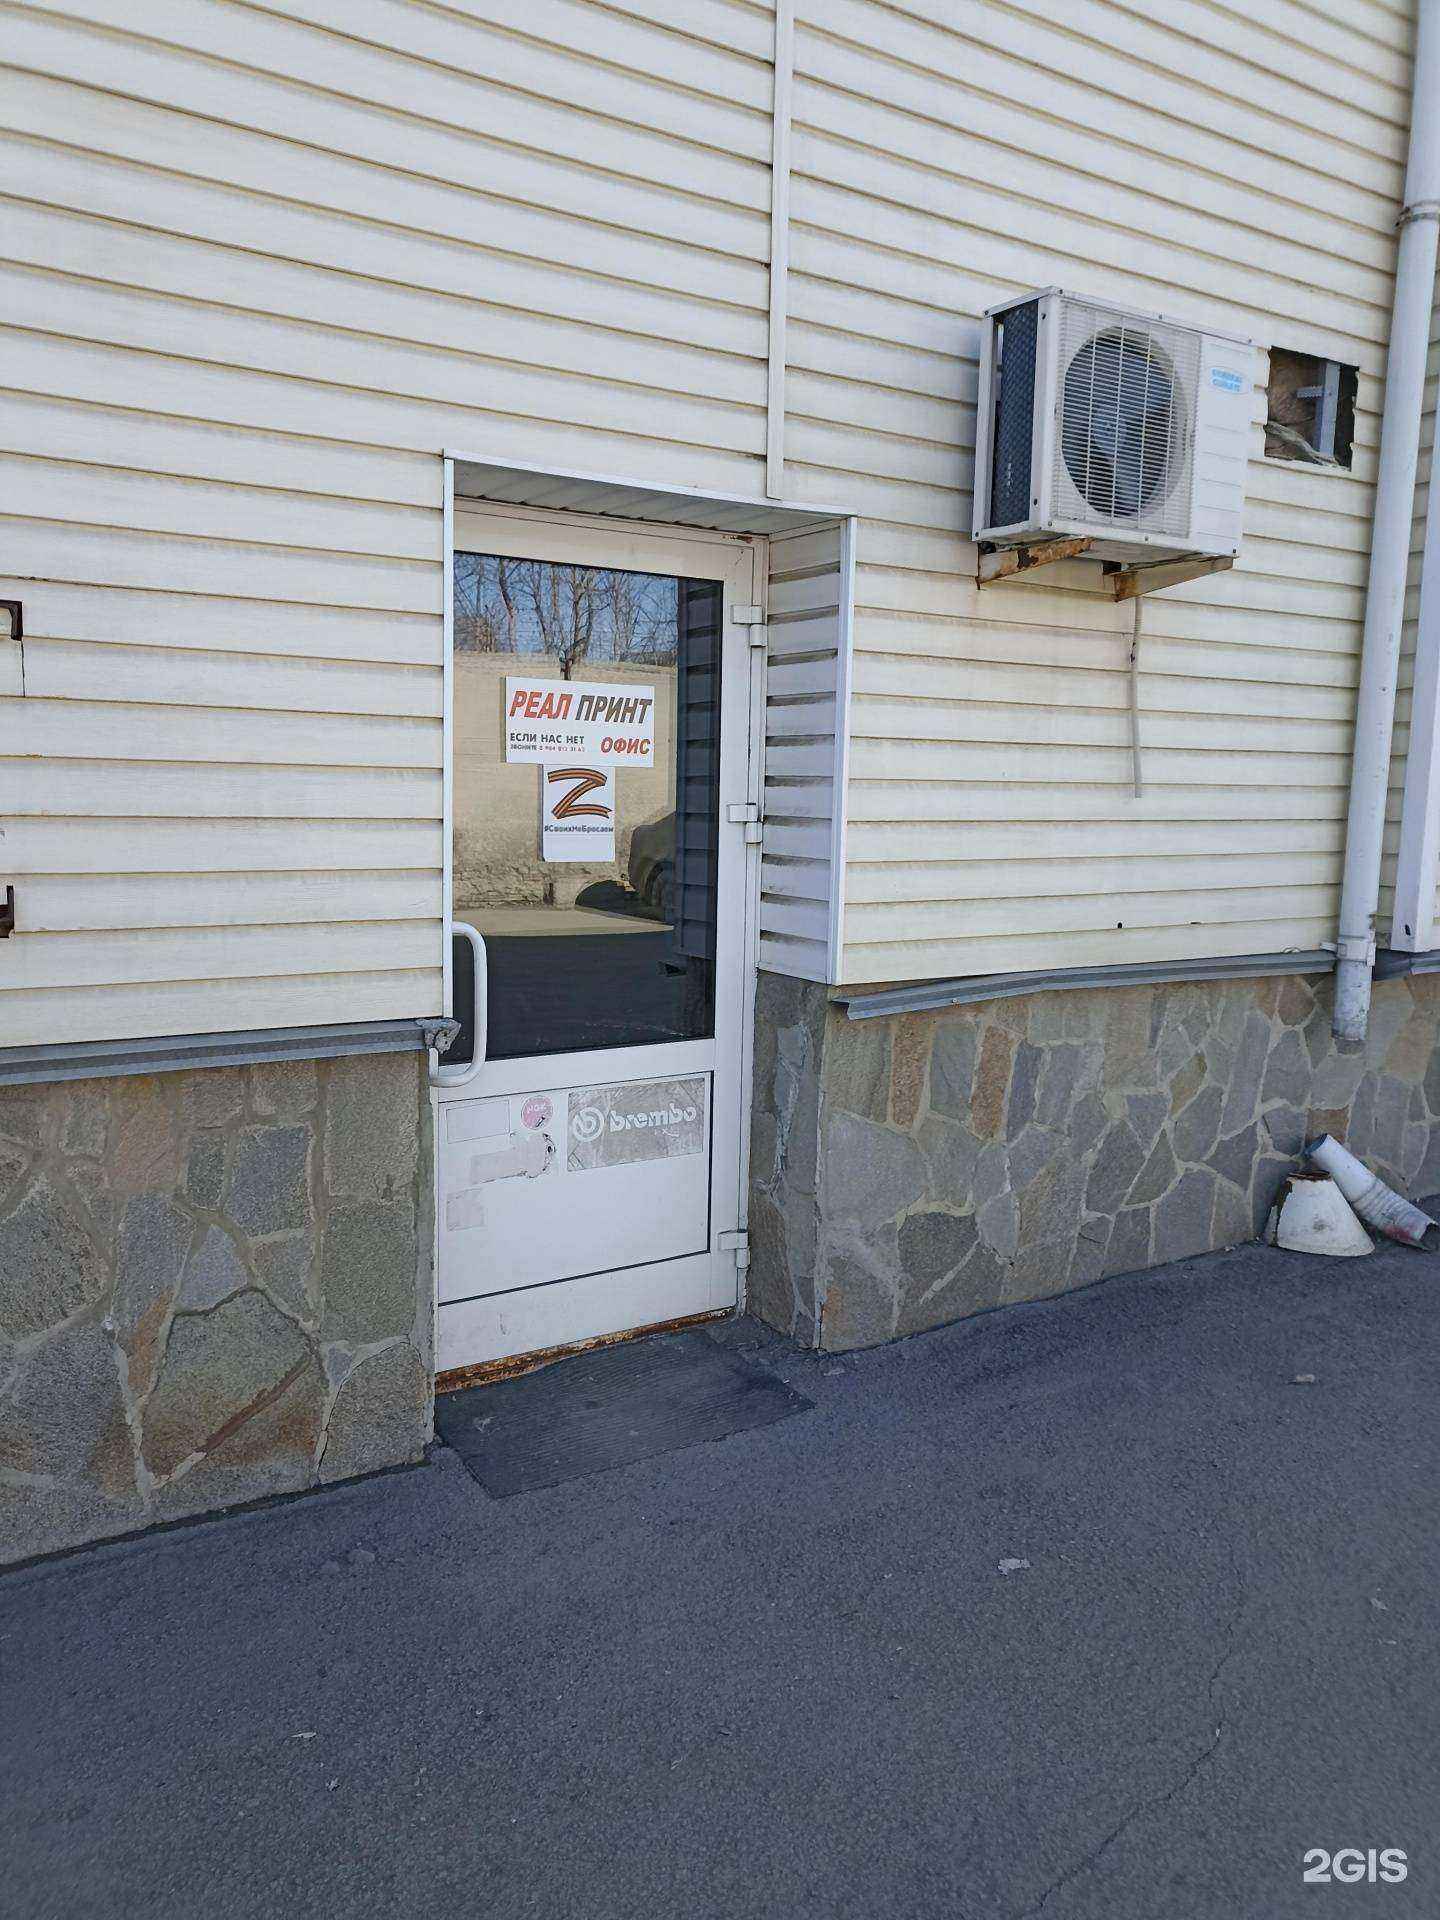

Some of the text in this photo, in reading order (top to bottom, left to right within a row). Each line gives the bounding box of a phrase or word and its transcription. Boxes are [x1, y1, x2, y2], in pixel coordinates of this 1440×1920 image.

[509, 690, 653, 724] РЕАЛ ПРИНТ
[510, 732, 585, 744] ЕСЛИ НАС НЕТ
[600, 736, 651, 755] ОФИС
[610, 1103, 697, 1132] brembo
